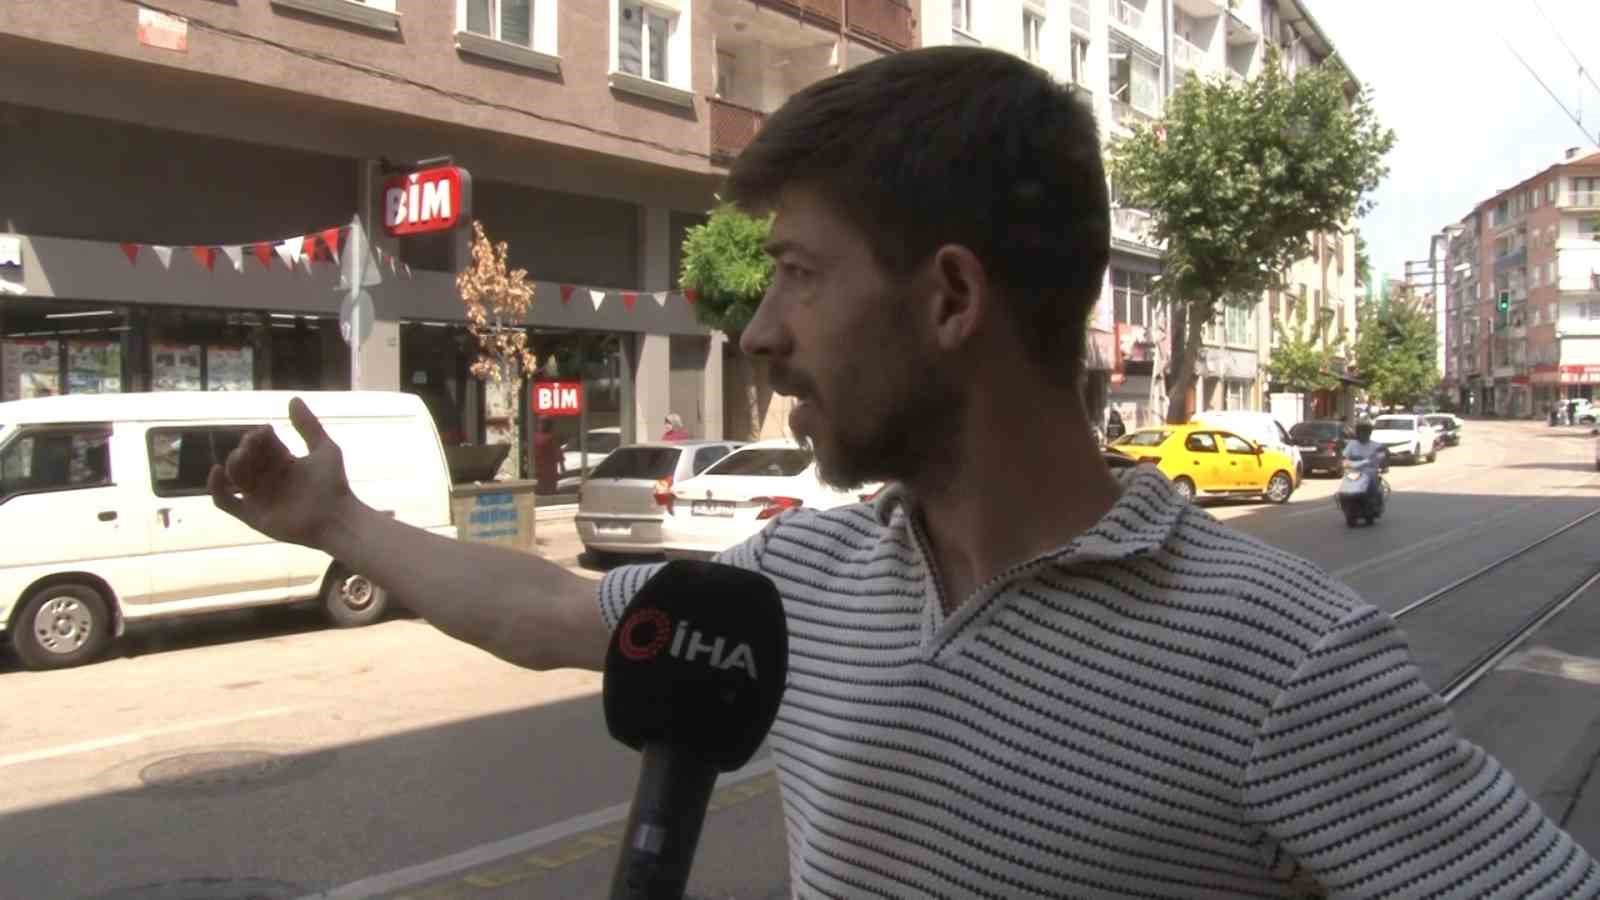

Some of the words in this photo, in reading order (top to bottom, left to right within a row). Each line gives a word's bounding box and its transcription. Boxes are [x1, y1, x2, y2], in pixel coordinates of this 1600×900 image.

[386, 173, 451, 226] BİM
[538, 382, 578, 409] BİM
[670, 620, 758, 680] İHA
